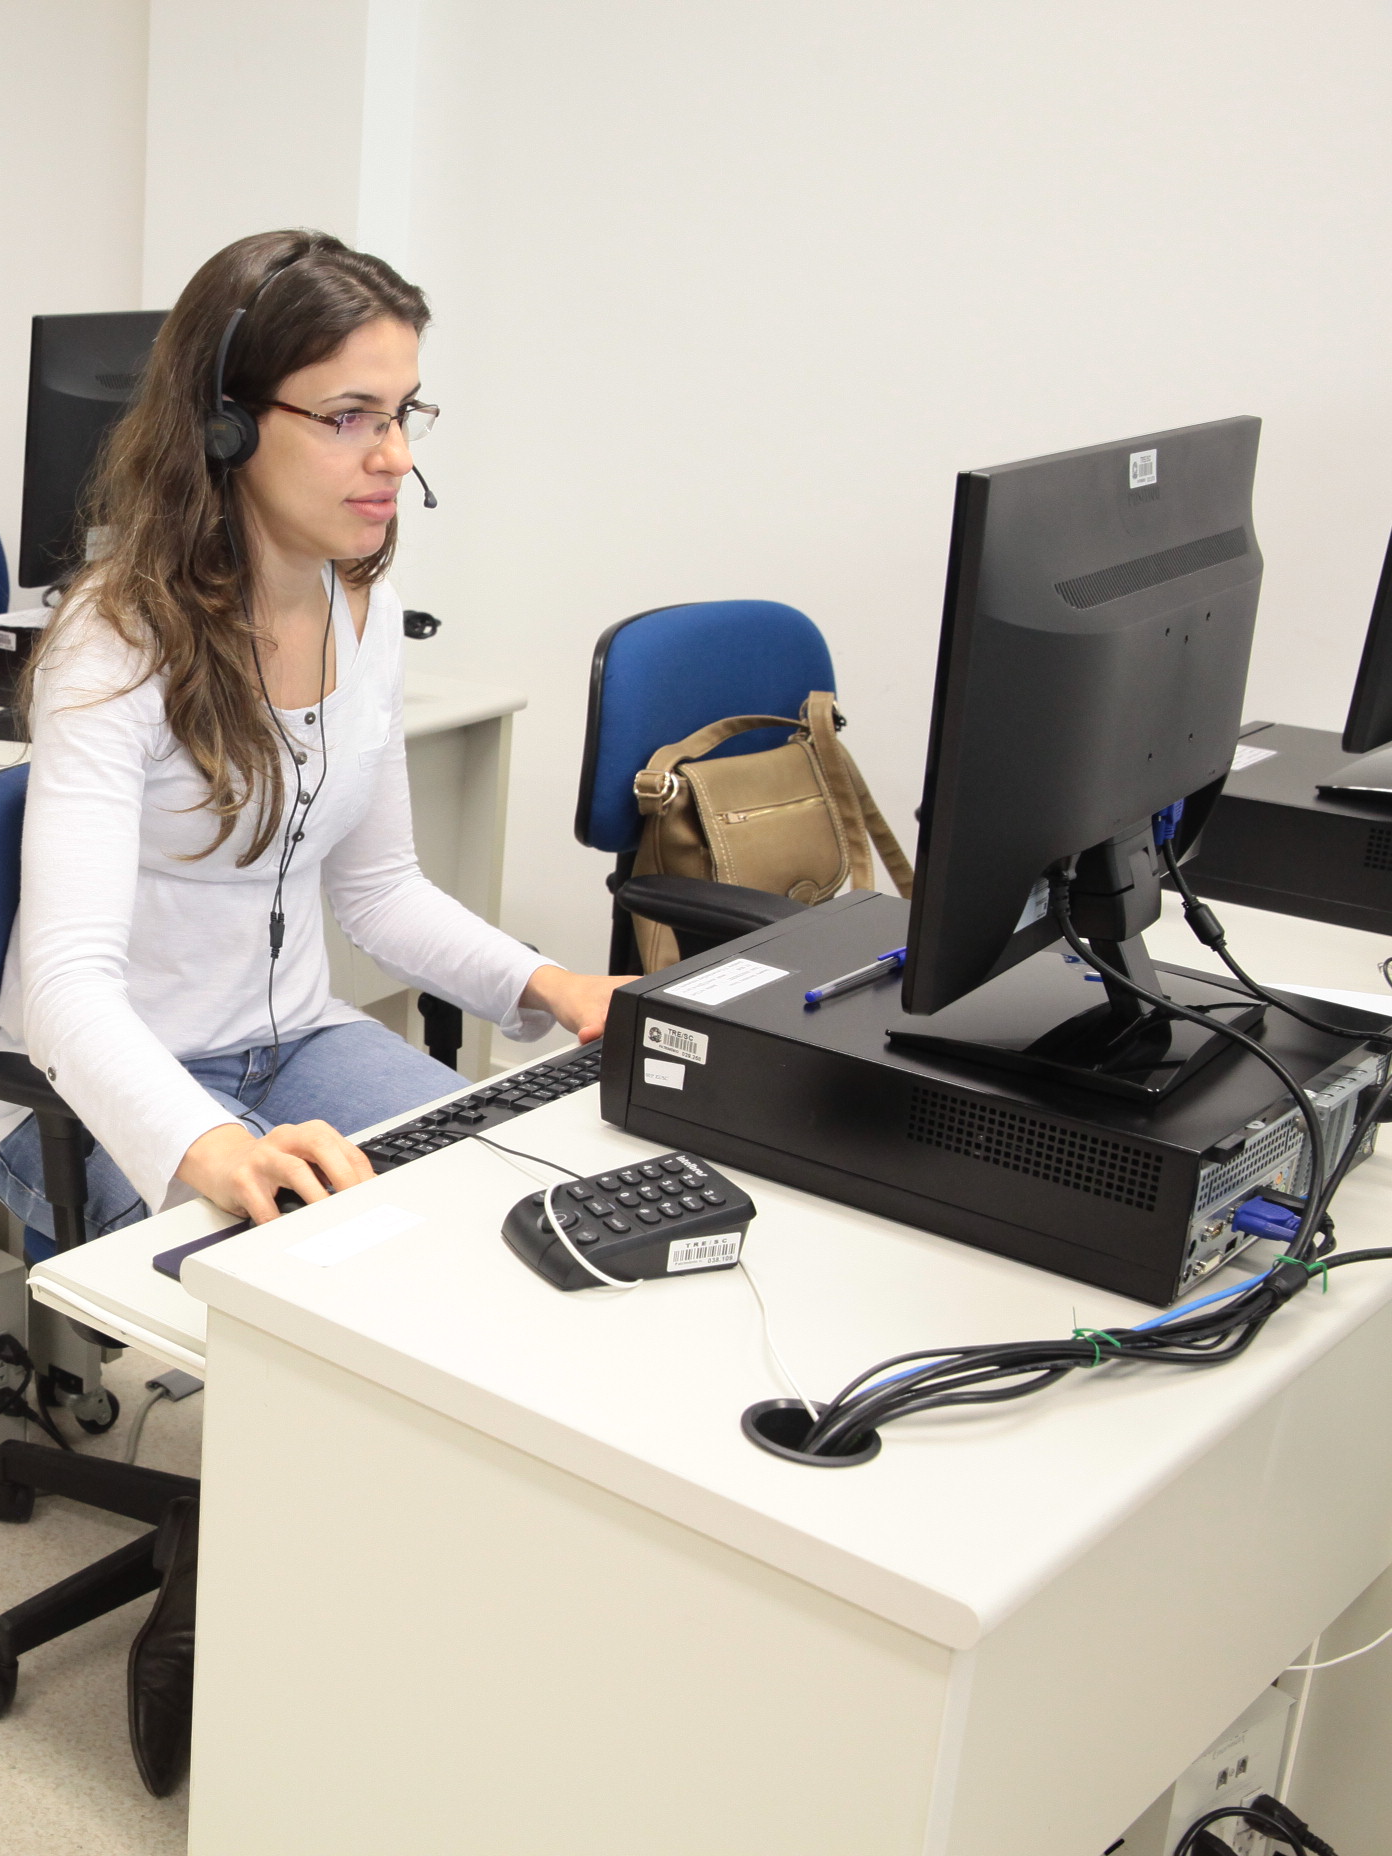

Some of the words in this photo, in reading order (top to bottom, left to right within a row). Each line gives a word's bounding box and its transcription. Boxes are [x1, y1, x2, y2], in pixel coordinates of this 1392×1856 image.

[667, 1027, 695, 1042] TRE/SC
[675, 1155, 709, 1178] intelbras
[685, 1238, 728, 1248] TRE/SC
